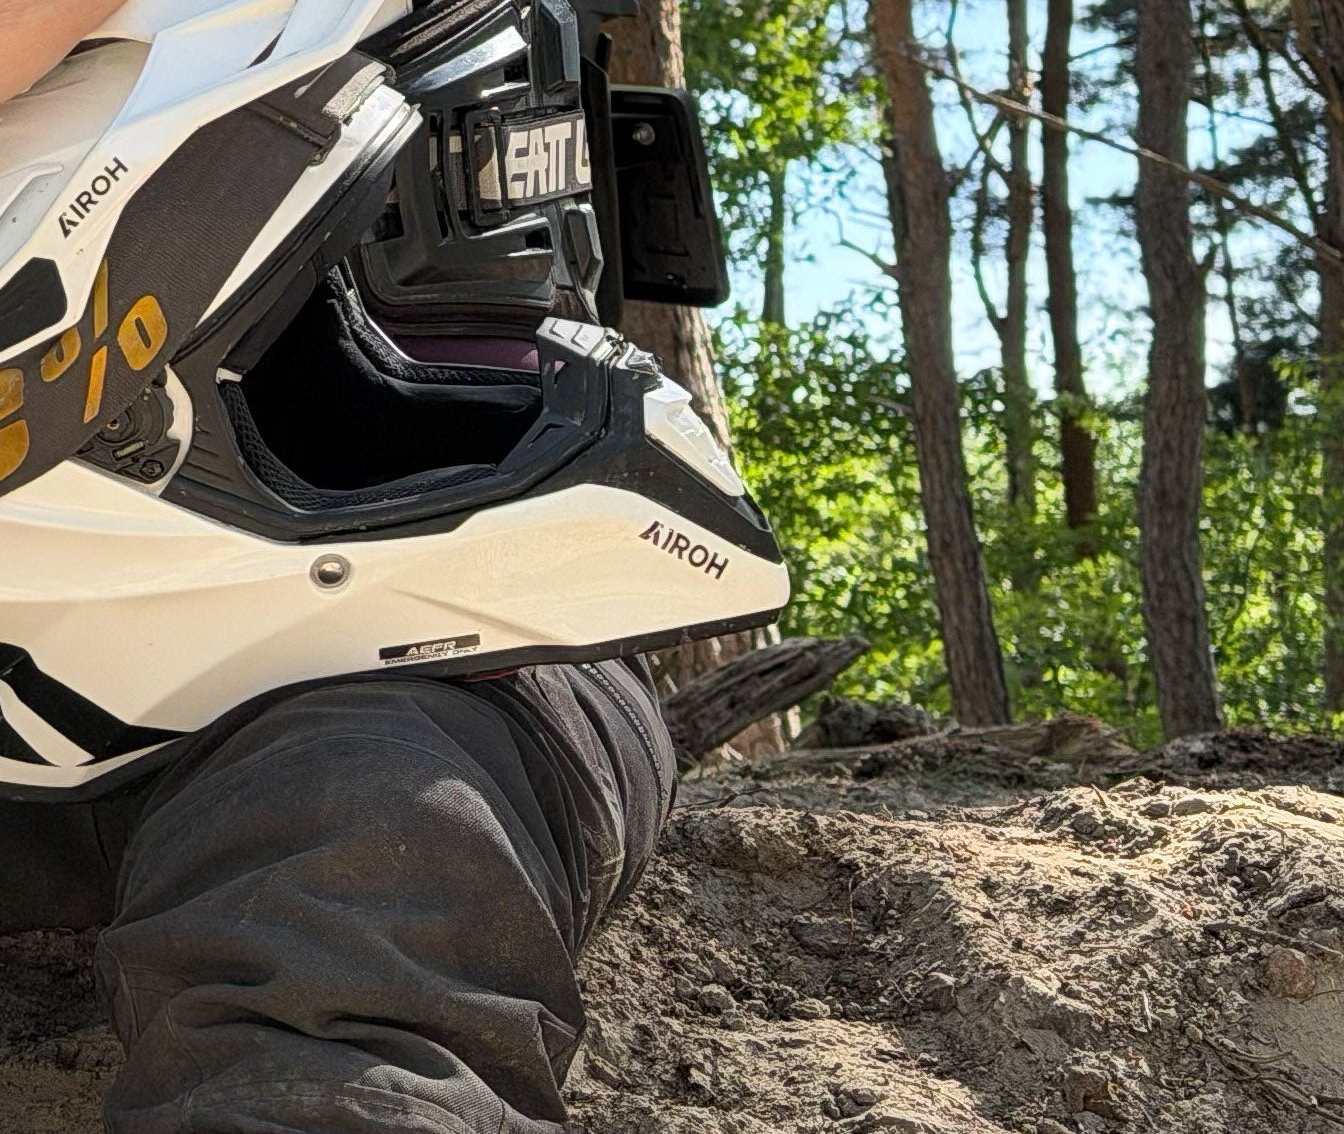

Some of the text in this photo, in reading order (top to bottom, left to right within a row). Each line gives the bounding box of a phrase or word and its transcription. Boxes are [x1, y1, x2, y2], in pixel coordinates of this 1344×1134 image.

[58, 156, 129, 240] AIROH
[504, 121, 572, 200] EATT
[638, 520, 730, 580] AIROH
